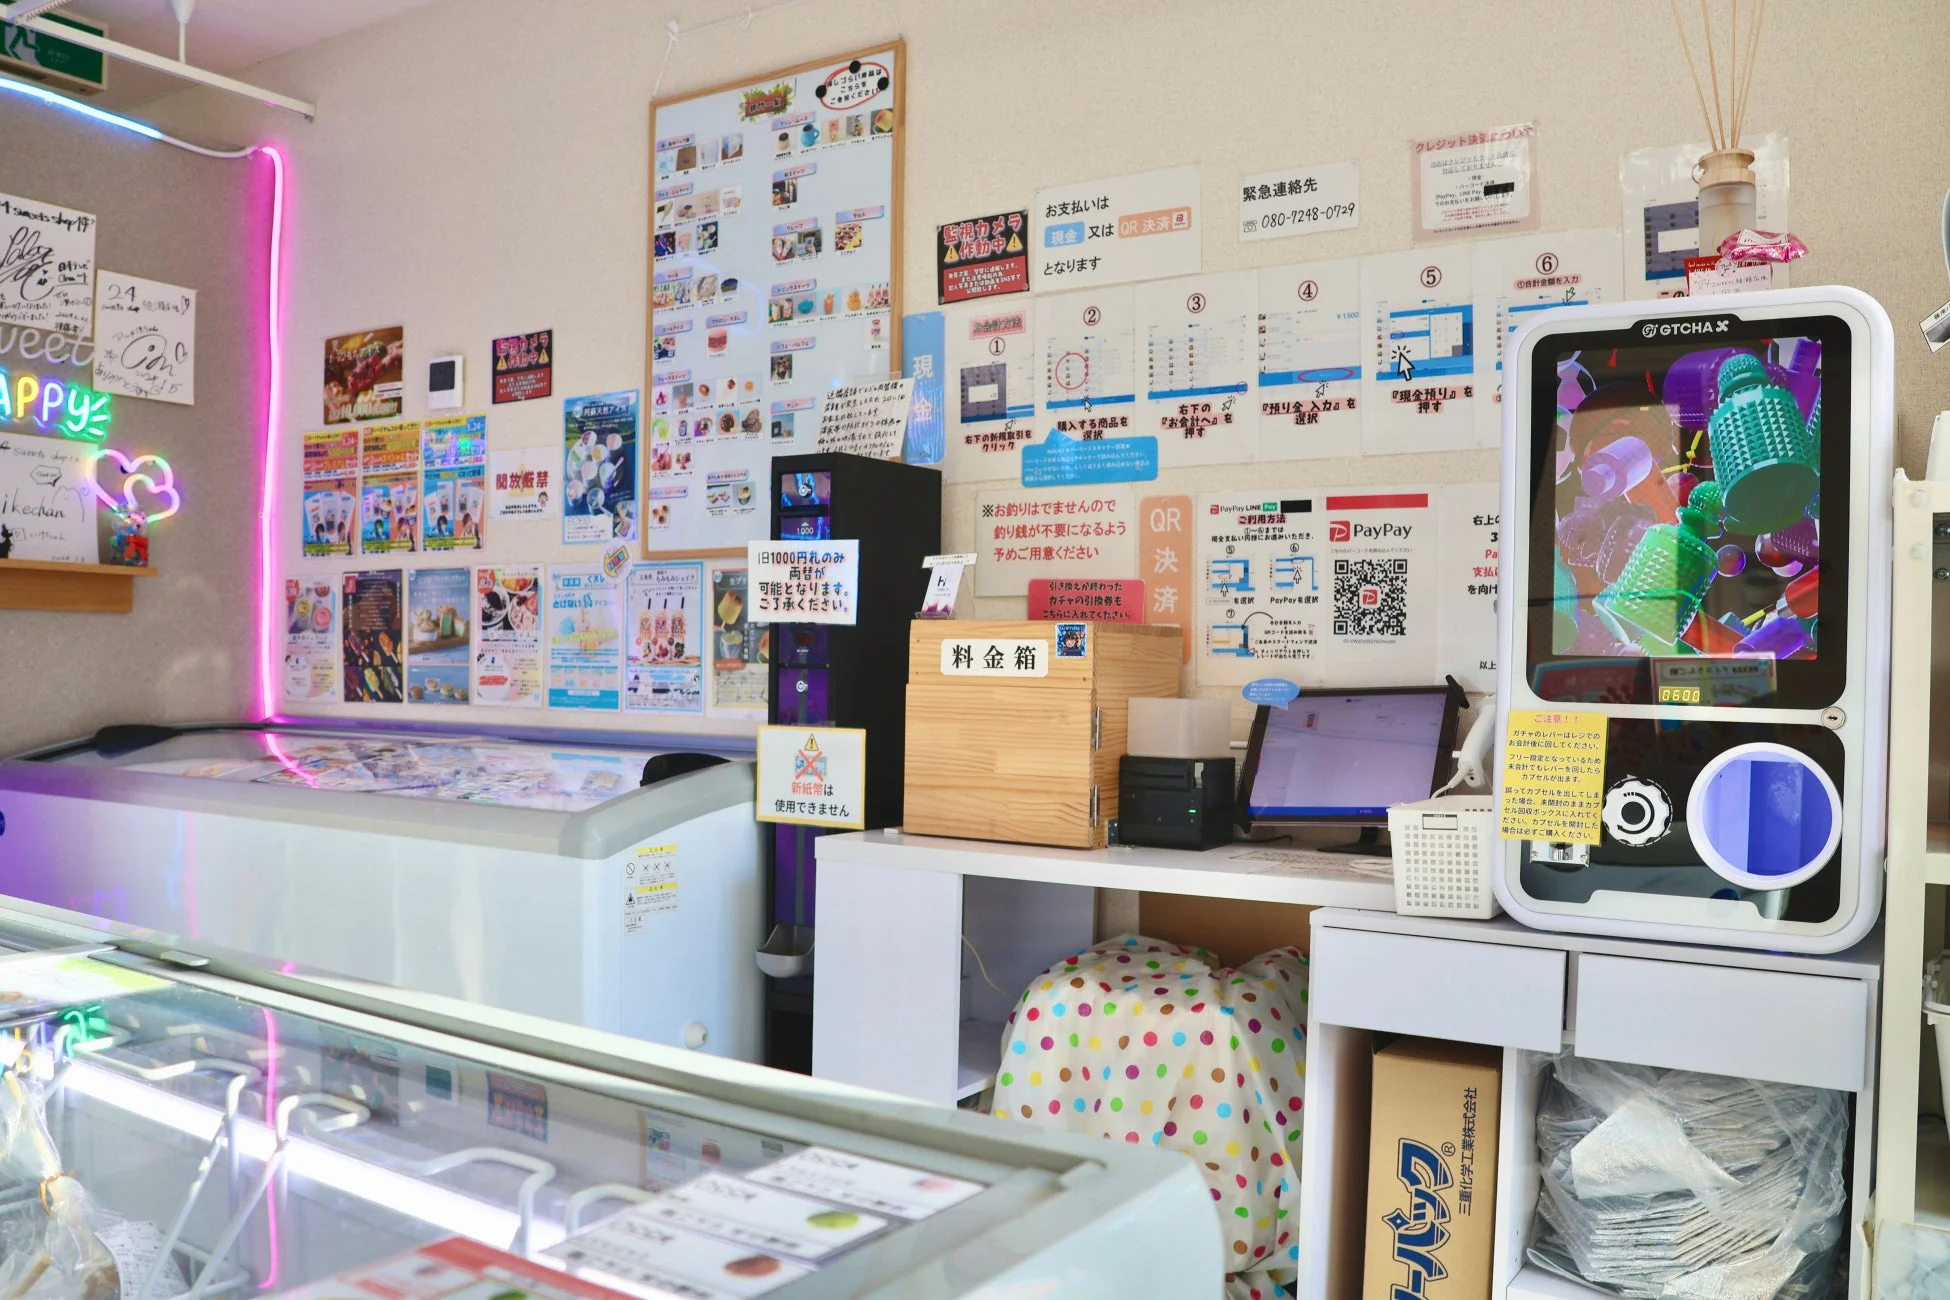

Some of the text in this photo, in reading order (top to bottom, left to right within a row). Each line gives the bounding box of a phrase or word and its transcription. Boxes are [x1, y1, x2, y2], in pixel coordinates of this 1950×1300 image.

[1415, 127, 1534, 154] クレジット決済について
[1243, 178, 1318, 202] 緊急連絡先
[1045, 196, 1109, 218] お支払いは
[1260, 203, 1356, 229] 080-7248-0729
[942, 214, 1023, 245] 監視カメラ
[1050, 217, 1170, 245] 現金 又は QR 決済
[958, 236, 1007, 260] 作動中
[1043, 256, 1101, 275] となります
[108, 284, 136, 302] 24
[1660, 322, 1713, 336] GTCHA
[912, 354, 933, 421] 現金
[1178, 403, 1211, 417] 右下の
[1418, 401, 1442, 414] 押す
[1057, 417, 1128, 432] 購入する商品を
[1295, 412, 1319, 425] 選択
[1082, 430, 1103, 441] 選択
[1184, 426, 1205, 439] 押す
[982, 441, 1015, 451] クリック
[496, 470, 549, 490] 開放厳禁
[1245, 504, 1261, 512] LINE
[1238, 513, 1286, 525] ご利用方法
[993, 522, 1126, 539] 釣り銭が不要になるよう
[1352, 523, 1413, 539] PayPay
[758, 552, 845, 565] 旧1000円札のみ
[993, 546, 1099, 561] 予めご用意ください
[789, 567, 825, 581] 両替が
[759, 582, 849, 597] 可能となります。
[1049, 581, 1122, 592] 引き換えが終わった
[759, 597, 849, 613] ご了承ください。
[1049, 595, 1121, 606] ガチャの引換券も
[952, 644, 1036, 671] 料金箱
[1662, 690, 1700, 702] 0600
[1513, 730, 1600, 740] ガチャのレバーはレジでの
[1509, 740, 1600, 750] お会計後に回してください。
[1509, 753, 1601, 764] フリー設定となっているため
[1507, 763, 1601, 774] 未会計でもレバーを回したら
[1521, 774, 1582, 783] カプセルが出ます。
[791, 782, 834, 796] 新紙幣は
[1505, 786, 1600, 798] 誤ってカプセルを出してしま
[774, 799, 850, 817] 使用できません
[1505, 797, 1600, 809] った場合、未開封のままカプ
[1503, 807, 1598, 818] セル回収ボックスに入れてく
[1502, 816, 1599, 829] ださい。カプセルを開封した
[1502, 827, 1596, 840] 場合は必ずご購入ください。
[1459, 1087, 1477, 1216] 三重化学工業株式会社
